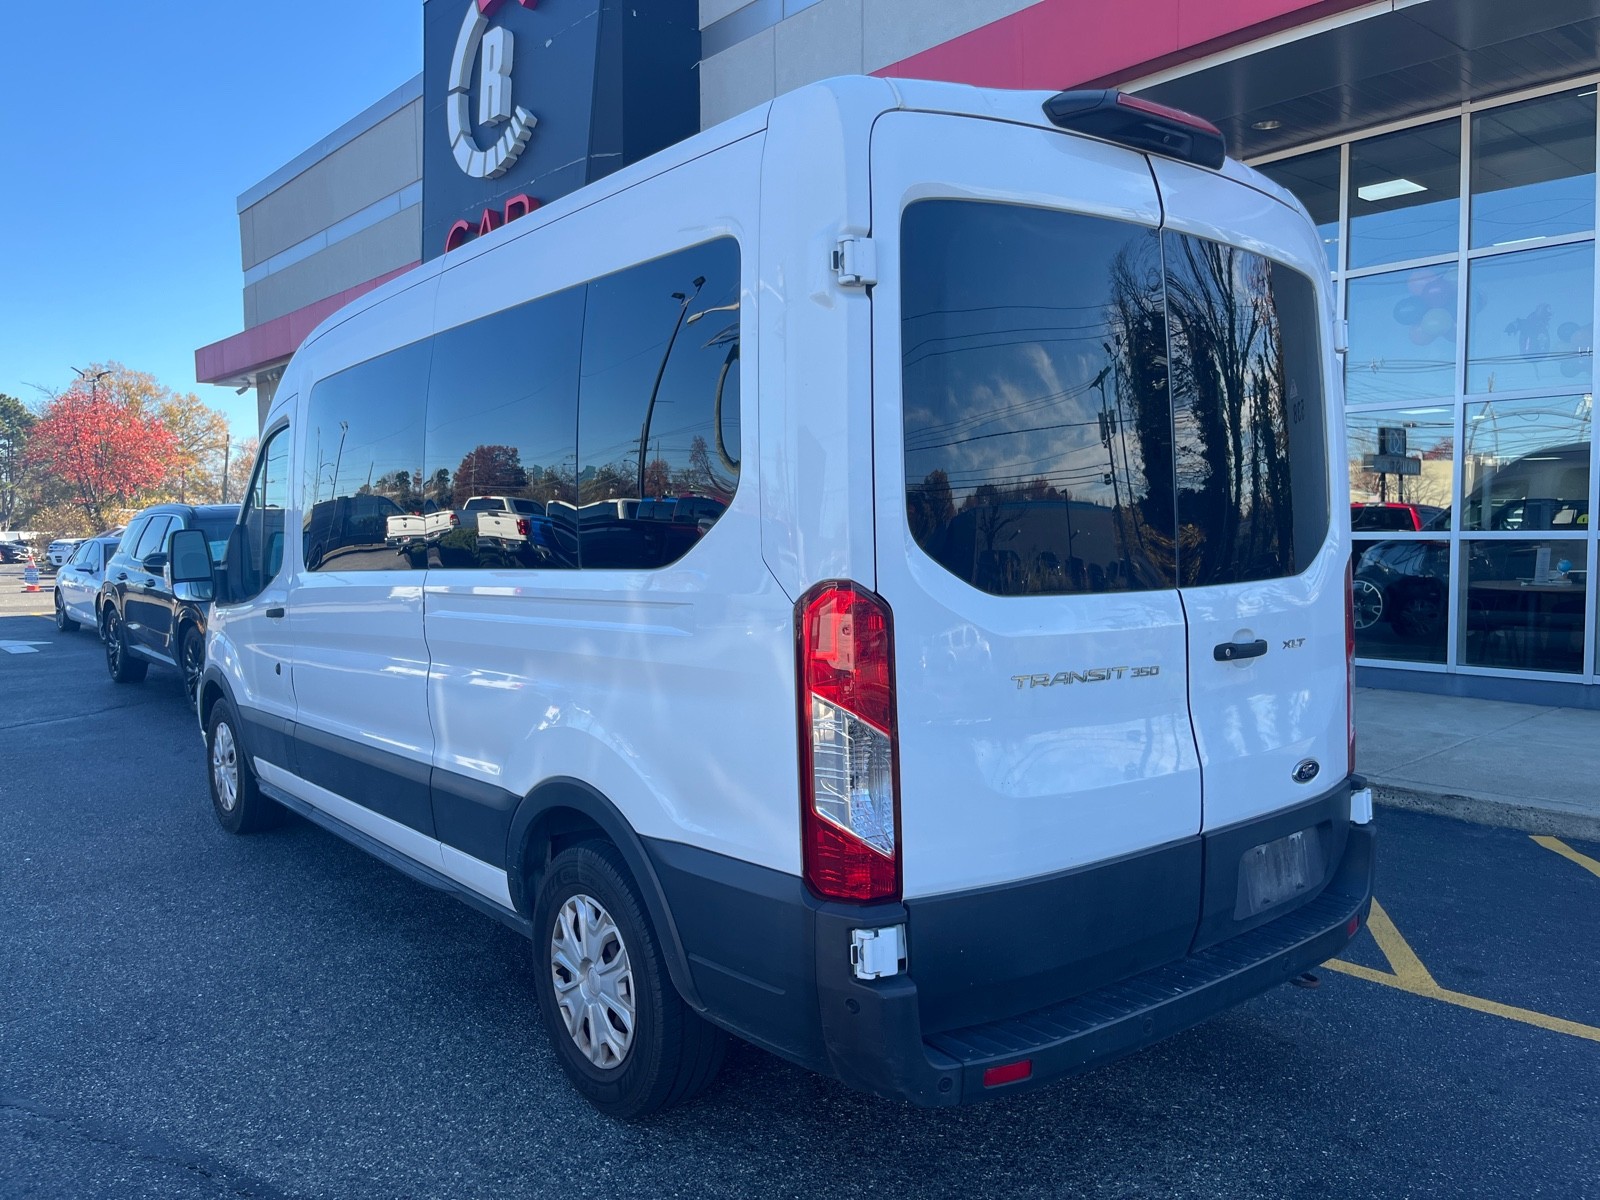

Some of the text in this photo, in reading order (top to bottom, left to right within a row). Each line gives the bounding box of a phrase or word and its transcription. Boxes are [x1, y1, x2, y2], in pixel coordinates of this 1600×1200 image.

[1282, 638, 1306, 650] XLT
[1010, 665, 1160, 689] TRANSIT 350
